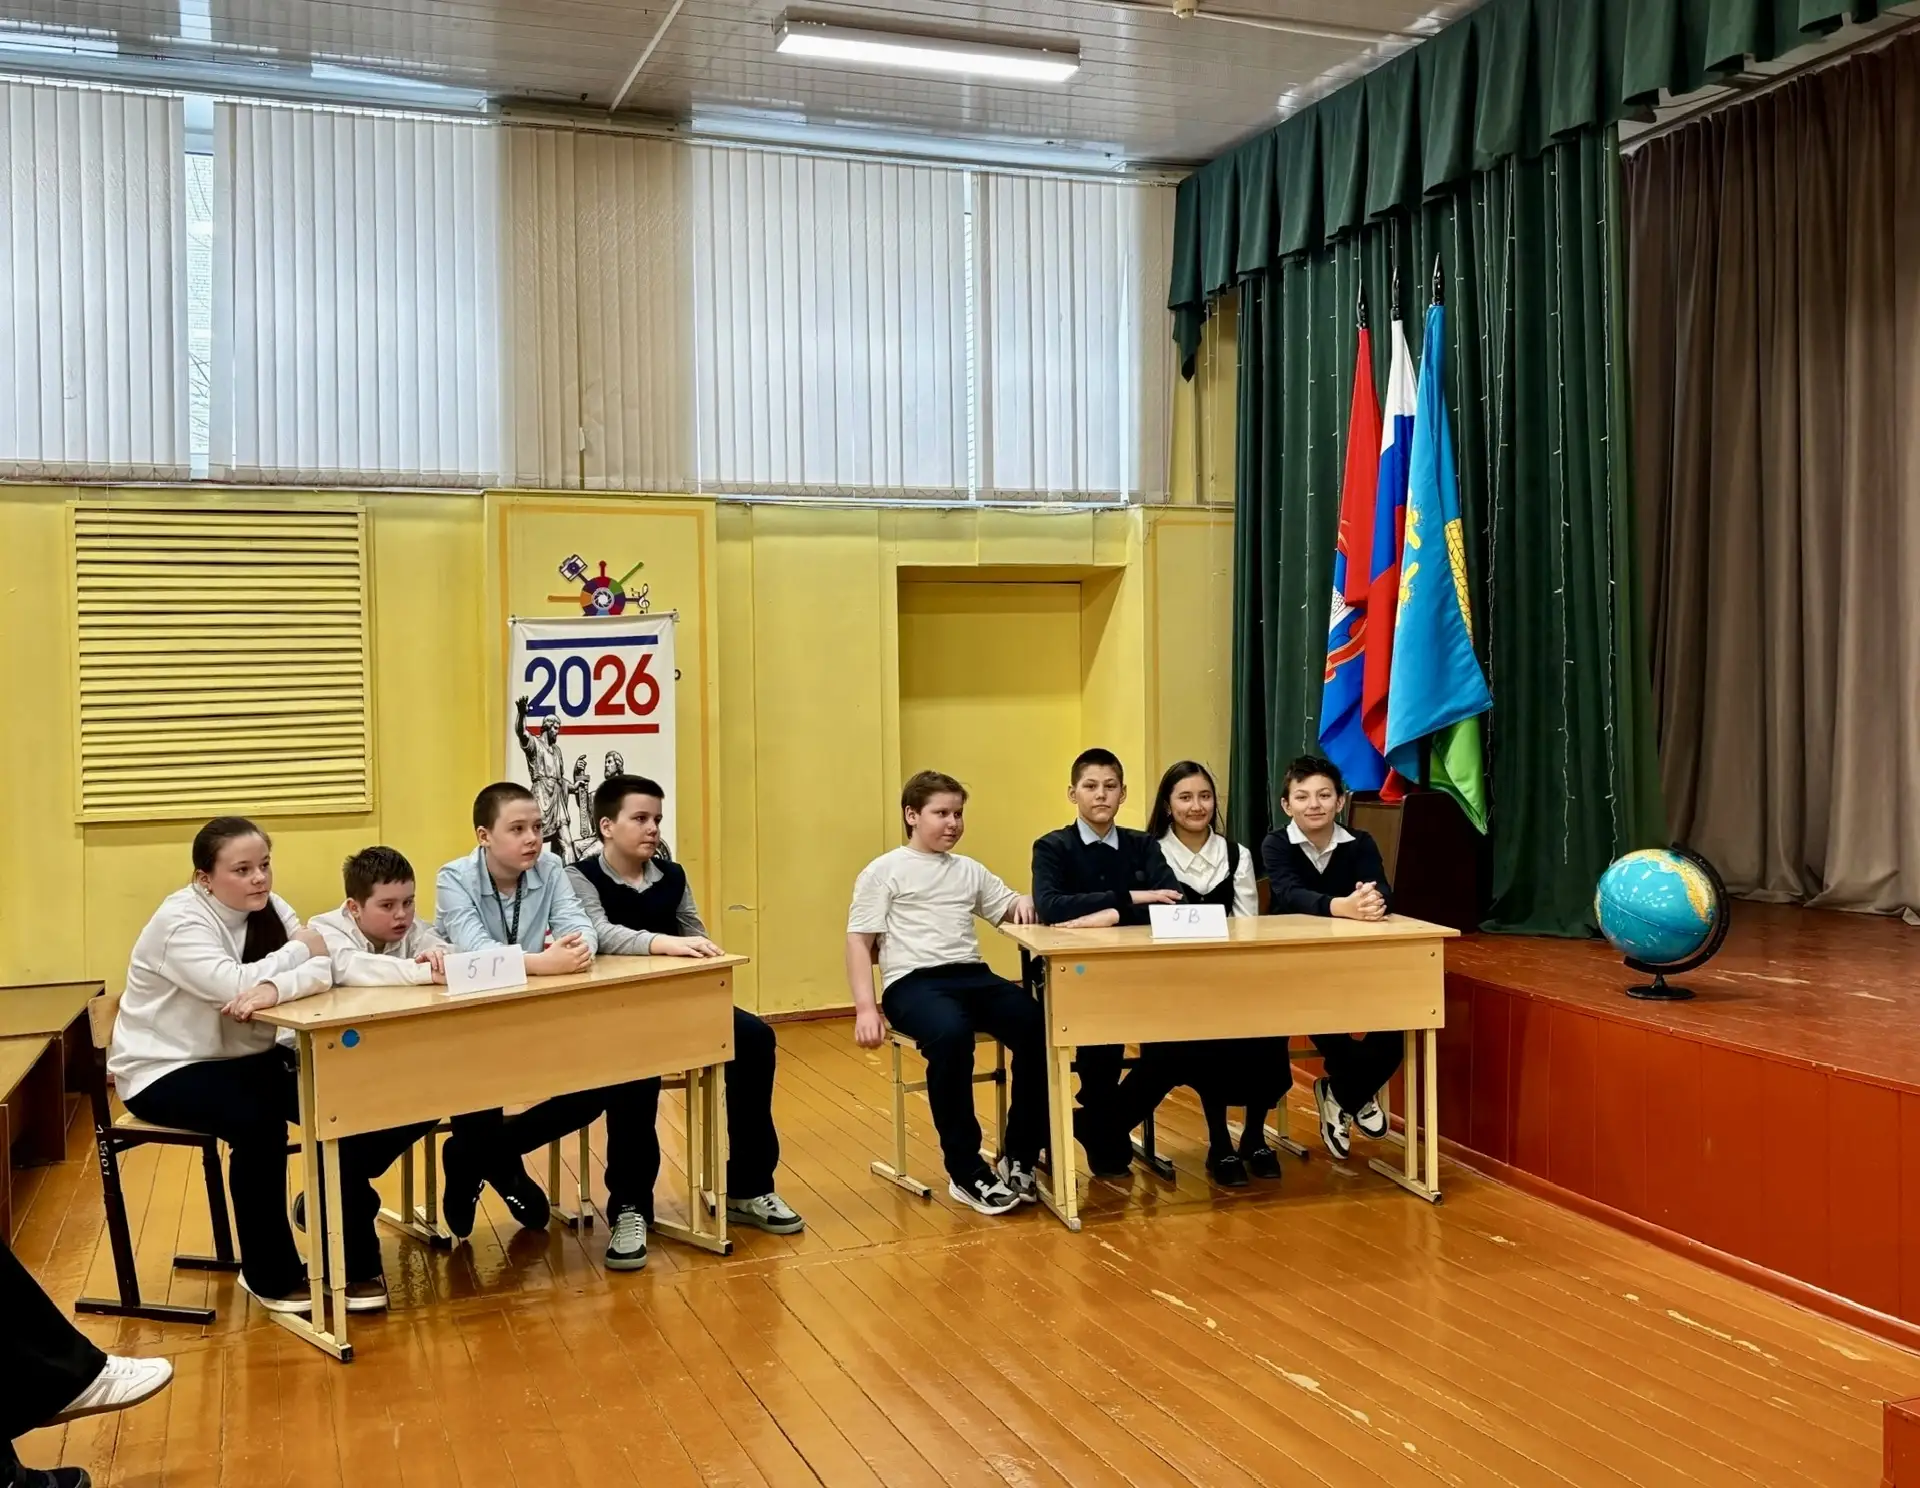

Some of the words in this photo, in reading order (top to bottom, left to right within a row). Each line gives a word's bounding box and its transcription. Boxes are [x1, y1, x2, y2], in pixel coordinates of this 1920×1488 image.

[524, 653, 660, 718] 2026
[1172, 907, 1188, 922] 5
[467, 957, 481, 980] 5
